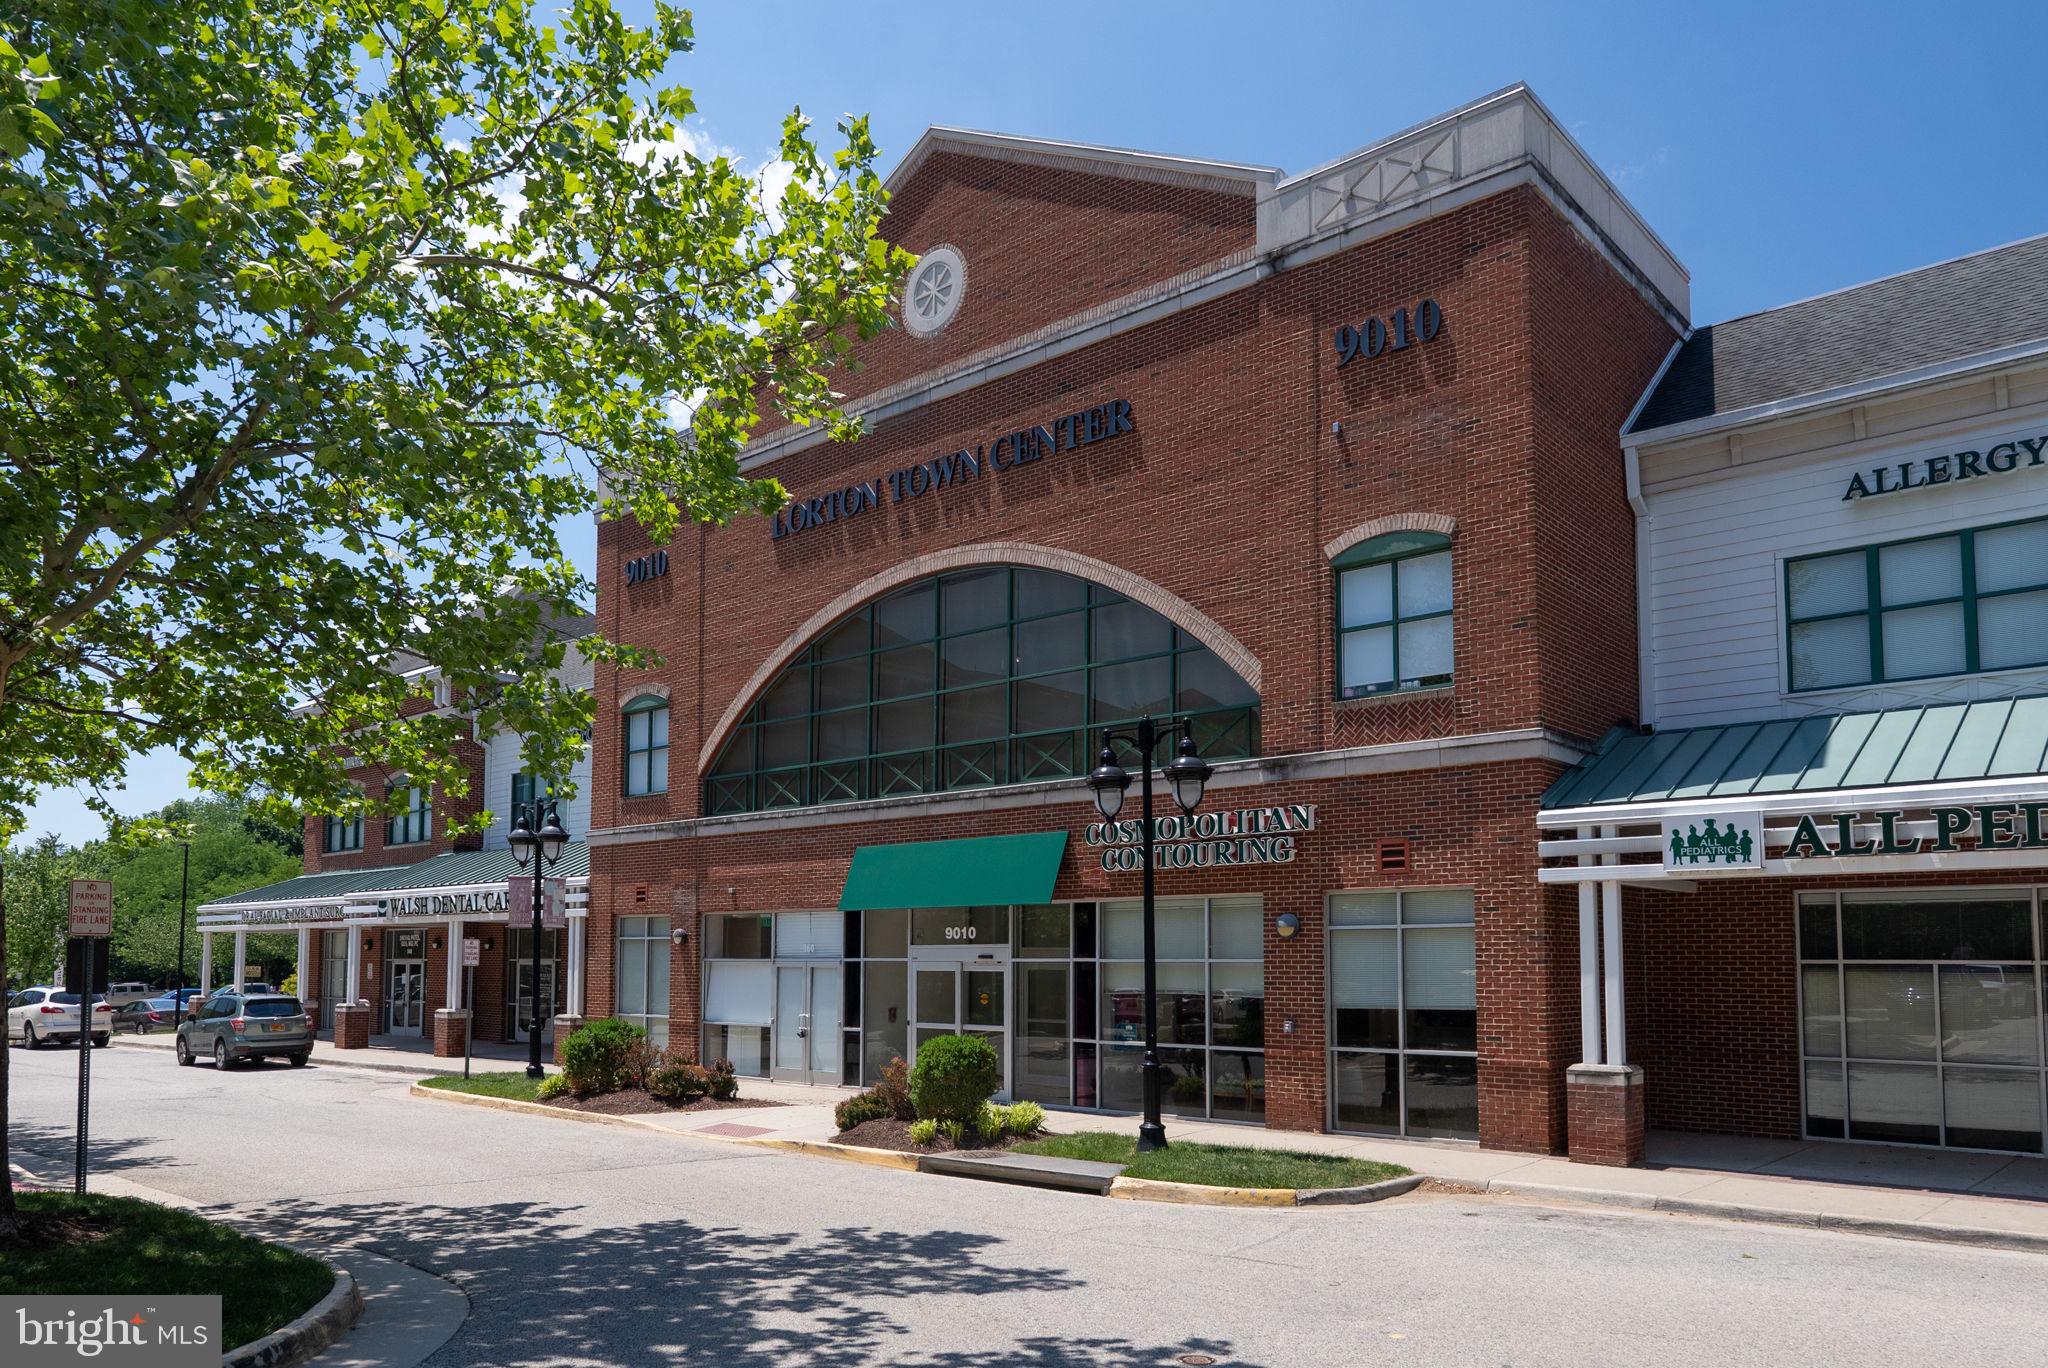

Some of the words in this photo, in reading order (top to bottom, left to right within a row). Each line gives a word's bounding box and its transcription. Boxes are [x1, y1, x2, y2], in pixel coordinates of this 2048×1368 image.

[1334, 297, 1442, 370] 9010
[771, 477, 880, 540] LORTON
[887, 444, 982, 502] TOWN
[988, 399, 1133, 473] CENTER
[1841, 434, 2048, 502] ALLERGY
[623, 548, 669, 588] 9010
[1085, 803, 1318, 846] COSMOPOLITAN
[1700, 838, 1721, 847] ALL
[1784, 812, 1921, 858] ALL
[1681, 845, 1742, 856] PEDIATRICS
[76, 892, 107, 900] PARKING
[87, 883, 97, 891] NO
[73, 906, 109, 914] STANDING
[390, 897, 429, 917] WALSH
[432, 893, 483, 914] DENTAL
[72, 915, 88, 924] FIRE
[90, 915, 109, 925] LANE
[945, 926, 976, 939] 9010
